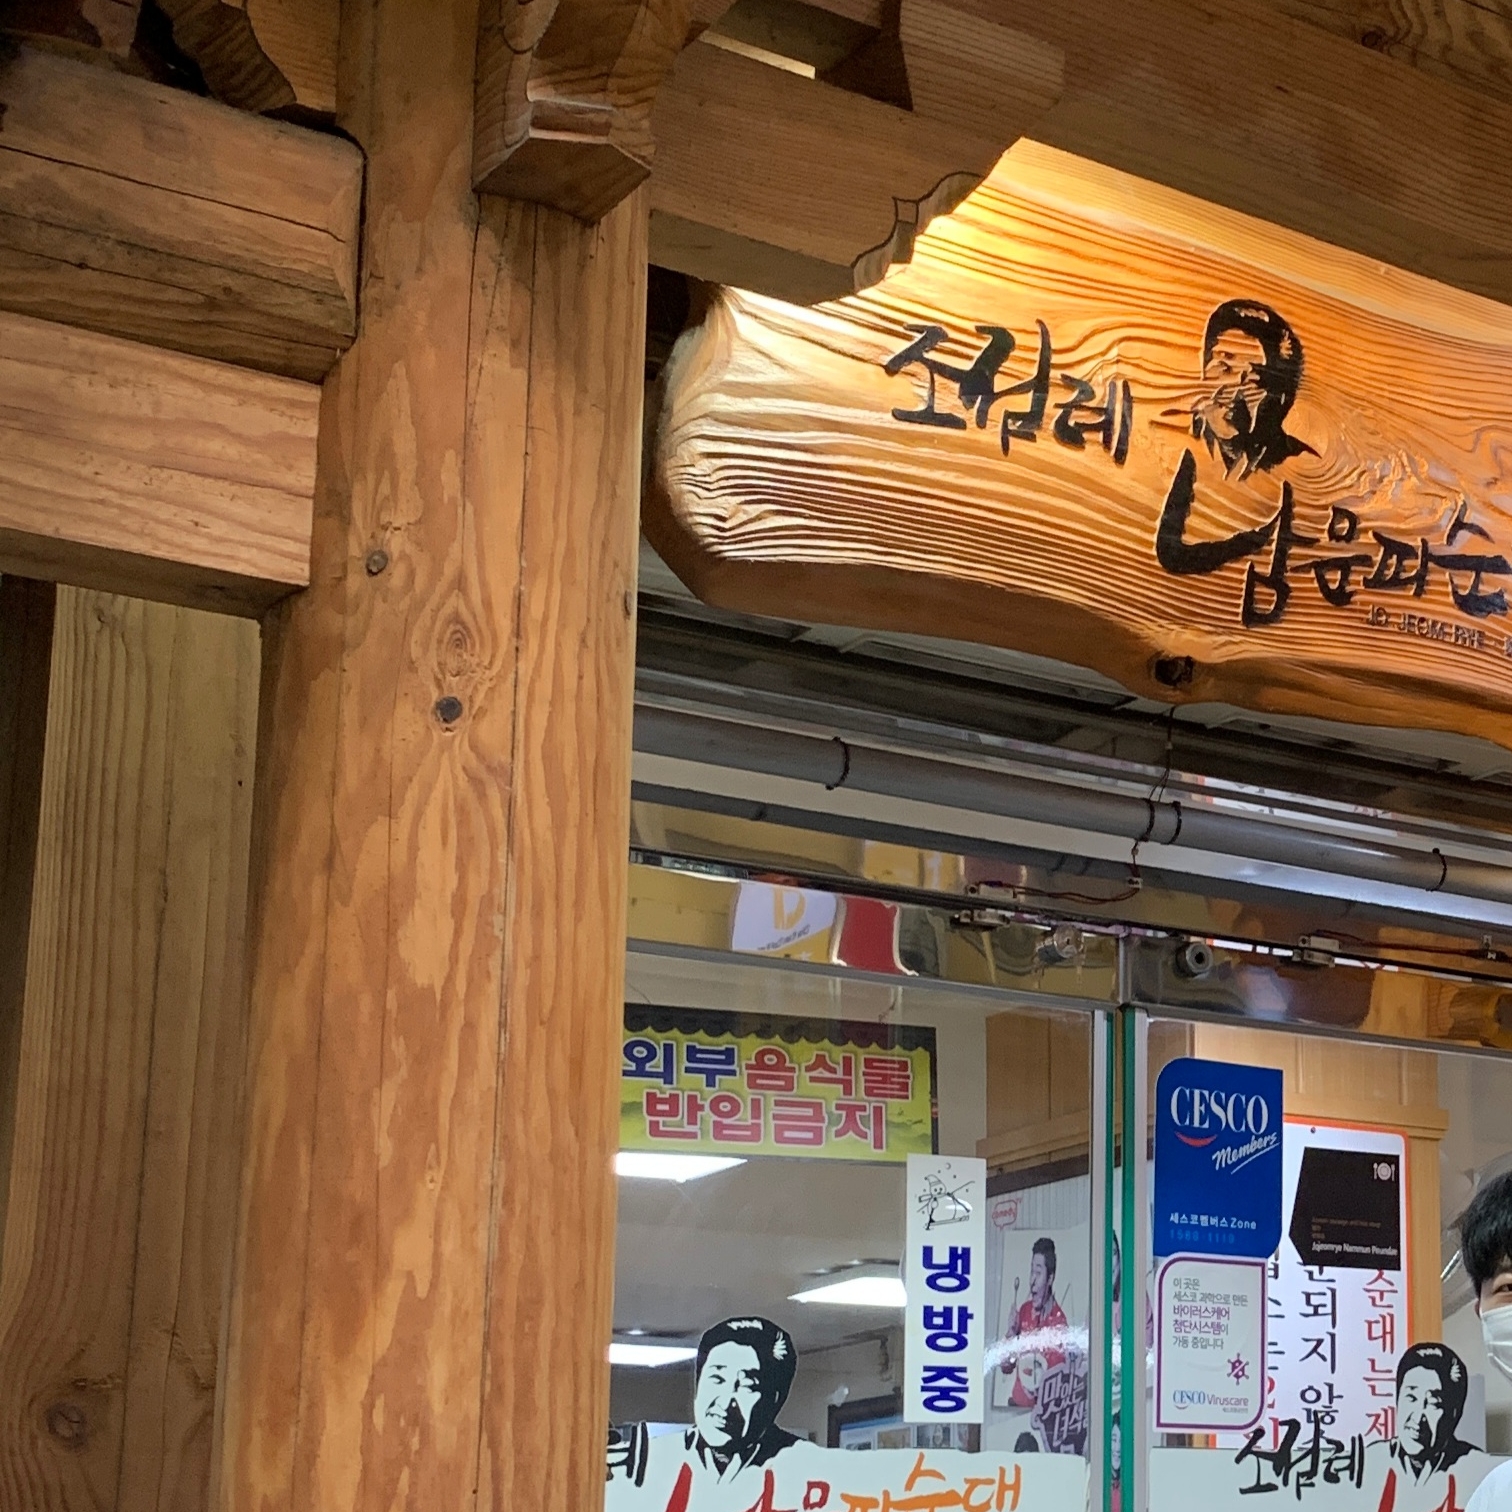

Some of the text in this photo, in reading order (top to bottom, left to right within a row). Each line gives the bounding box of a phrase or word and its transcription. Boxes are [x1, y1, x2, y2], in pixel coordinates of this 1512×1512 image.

[883, 319, 1133, 466] 조점례
[645, 1091, 886, 1151] 반입금지
[1170, 1086, 1269, 1136] CESCO
[1212, 1132, 1278, 1171] Members
[920, 1245, 974, 1414] 냉방중
[1173, 1305, 1231, 1321] 바이러스케어
[1172, 1336, 1224, 1350] 가동 중입니다
[1173, 1389, 1249, 1406] CESCO Viruscare
